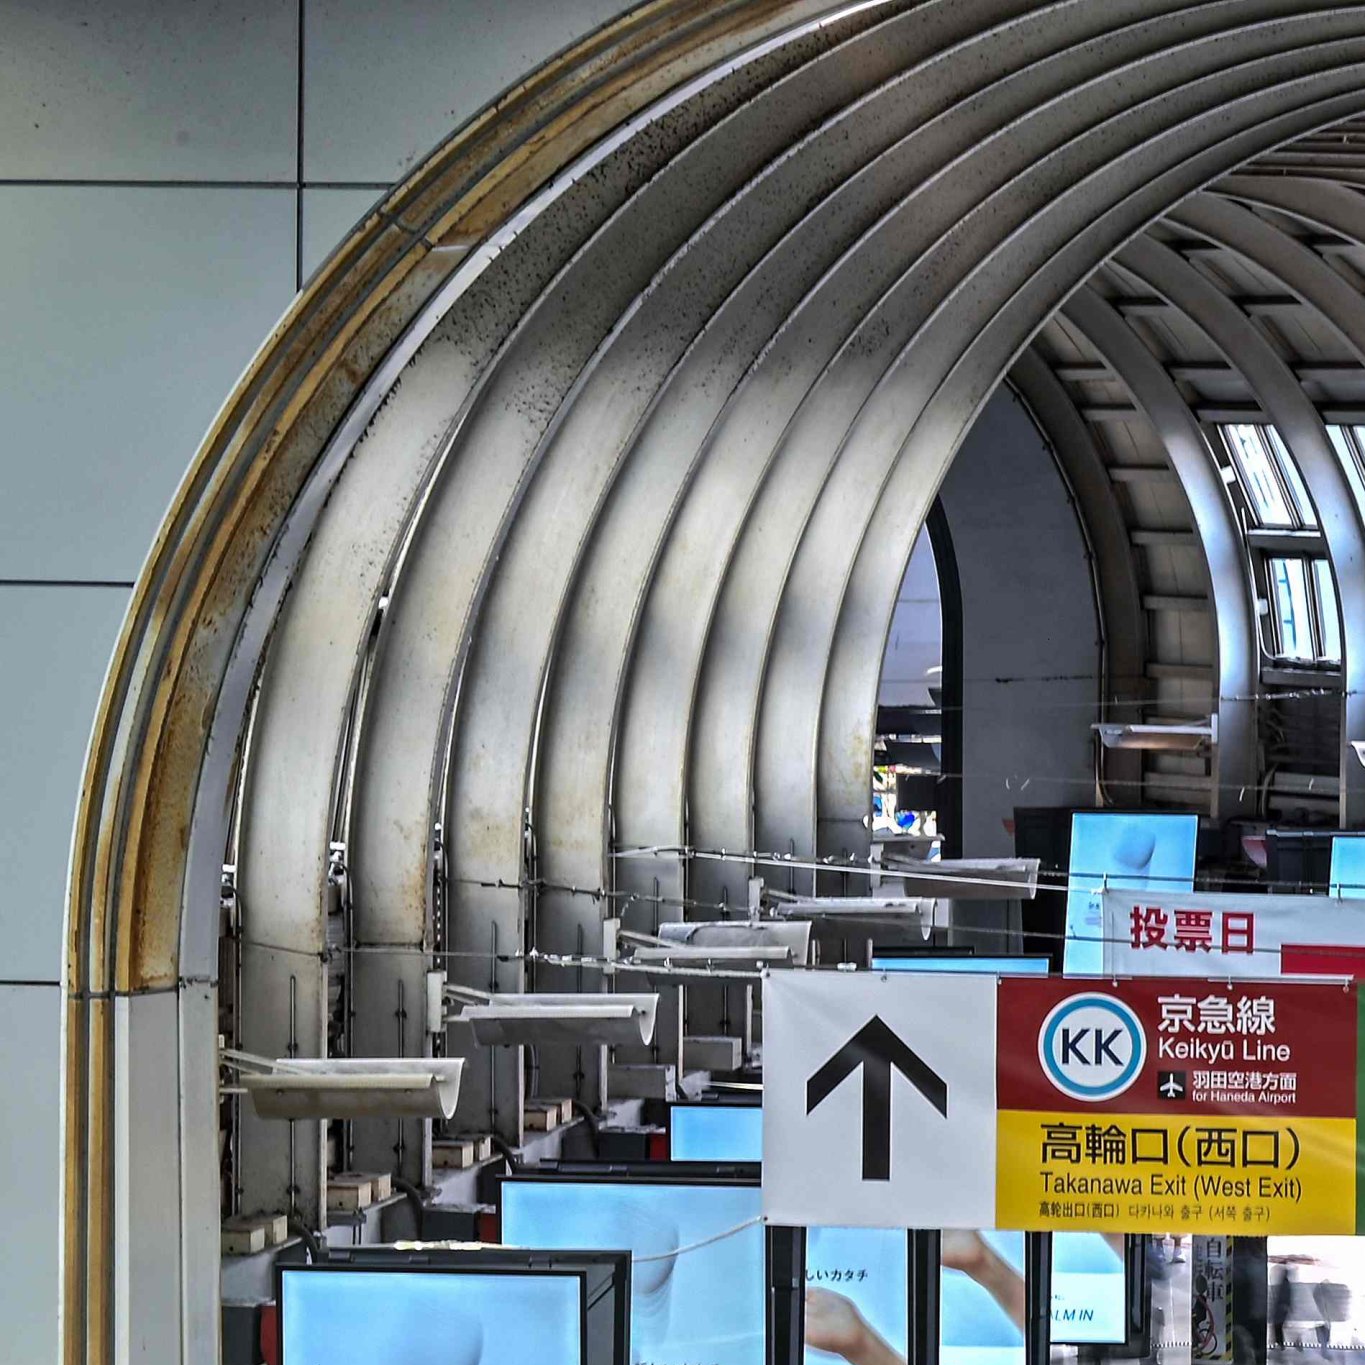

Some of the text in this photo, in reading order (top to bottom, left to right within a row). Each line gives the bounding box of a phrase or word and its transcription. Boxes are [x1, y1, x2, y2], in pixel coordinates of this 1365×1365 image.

[1130, 906, 1255, 953] 投票日
[1157, 995, 1276, 1035] 京急線
[1061, 1028, 1124, 1067] KK
[1158, 1037, 1291, 1063] Keikyū Line
[1192, 1070, 1297, 1091] 羽田空港方面
[1192, 1090, 1297, 1105] for Haneda Airport
[1041, 1123, 1300, 1169] 高輪口(西口)
[1040, 1172, 1301, 1203] Takanawa Exit (West Exit)
[1129, 1205, 1174, 1219] 다카나와
[1181, 1206, 1202, 1220] 출구
